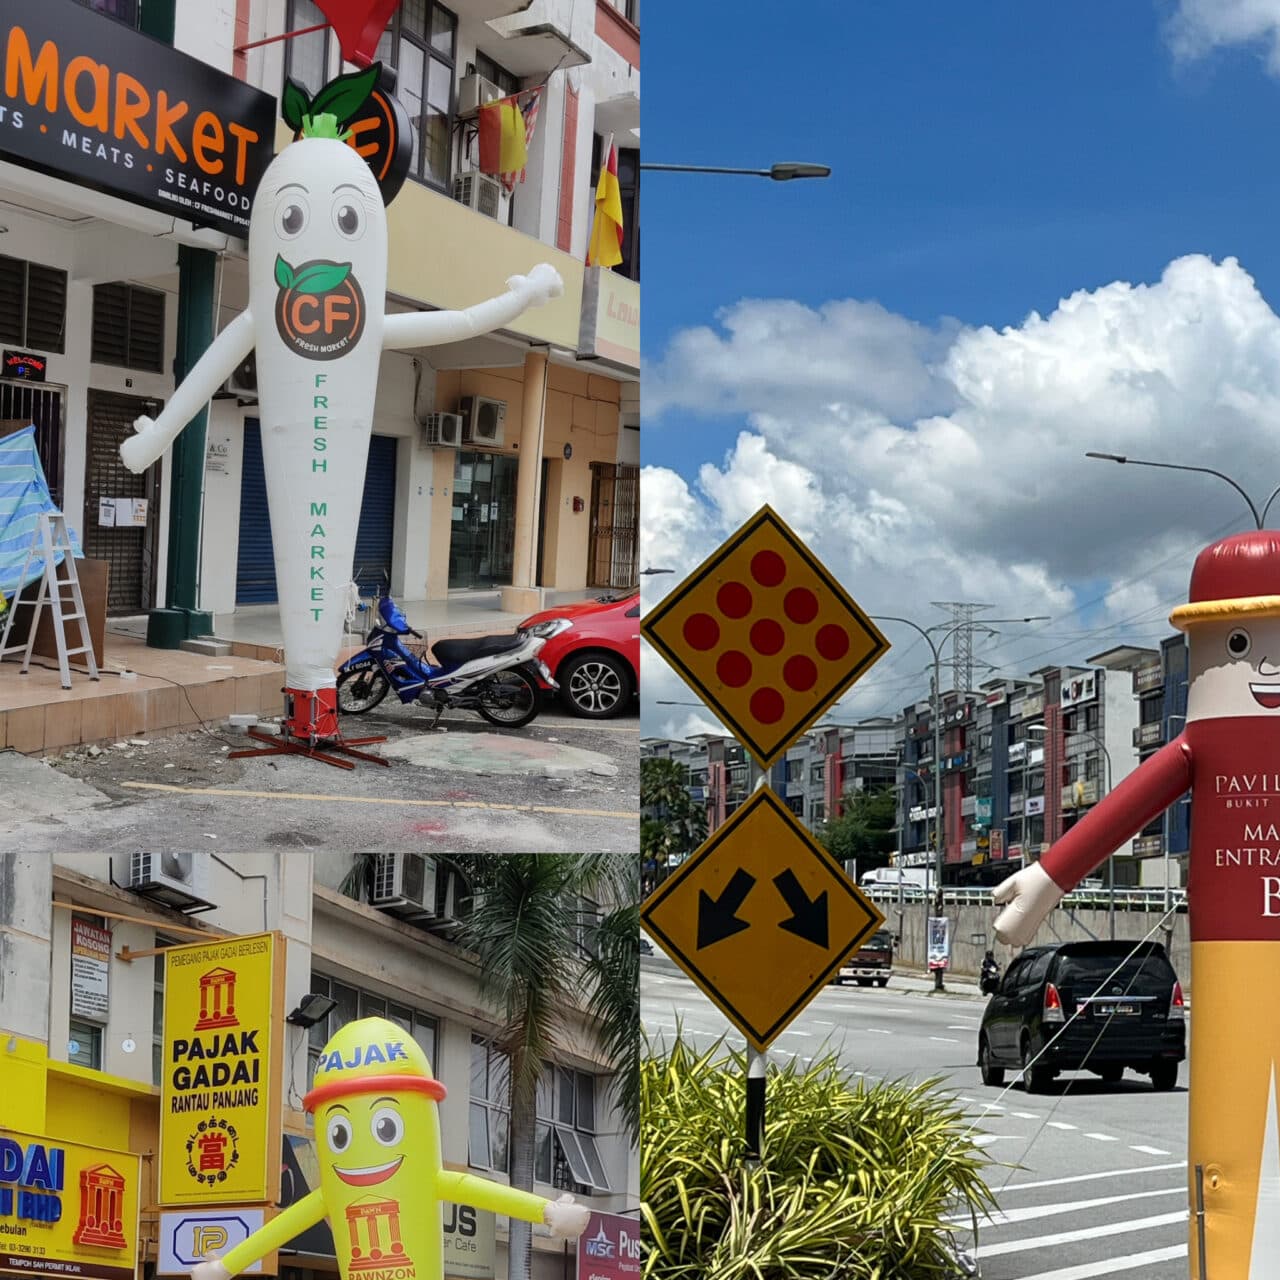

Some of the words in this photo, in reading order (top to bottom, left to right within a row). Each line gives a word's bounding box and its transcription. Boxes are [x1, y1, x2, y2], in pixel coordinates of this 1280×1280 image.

[62, 129, 134, 169] MEATS
[165, 168, 250, 210] SEAFOOD
[292, 294, 352, 335] CF
[311, 373, 329, 473] FRESH
[310, 502, 328, 622] MARKET
[1226, 799, 1270, 808] BUKIT
[171, 952, 201, 968] PEMEGANG
[202, 949, 220, 962] PAJAK
[220, 946, 238, 960] GADAI
[238, 942, 268, 957] BERLESEN
[173, 1030, 260, 1063] PAJAK
[315, 1041, 408, 1075] PAJAK
[172, 1059, 260, 1091] GADAI
[171, 1091, 210, 1114] RANTAU
[212, 1088, 258, 1110] PANJANG
[455, 1238, 478, 1253] Cafe
[586, 1241, 616, 1259] MSC
